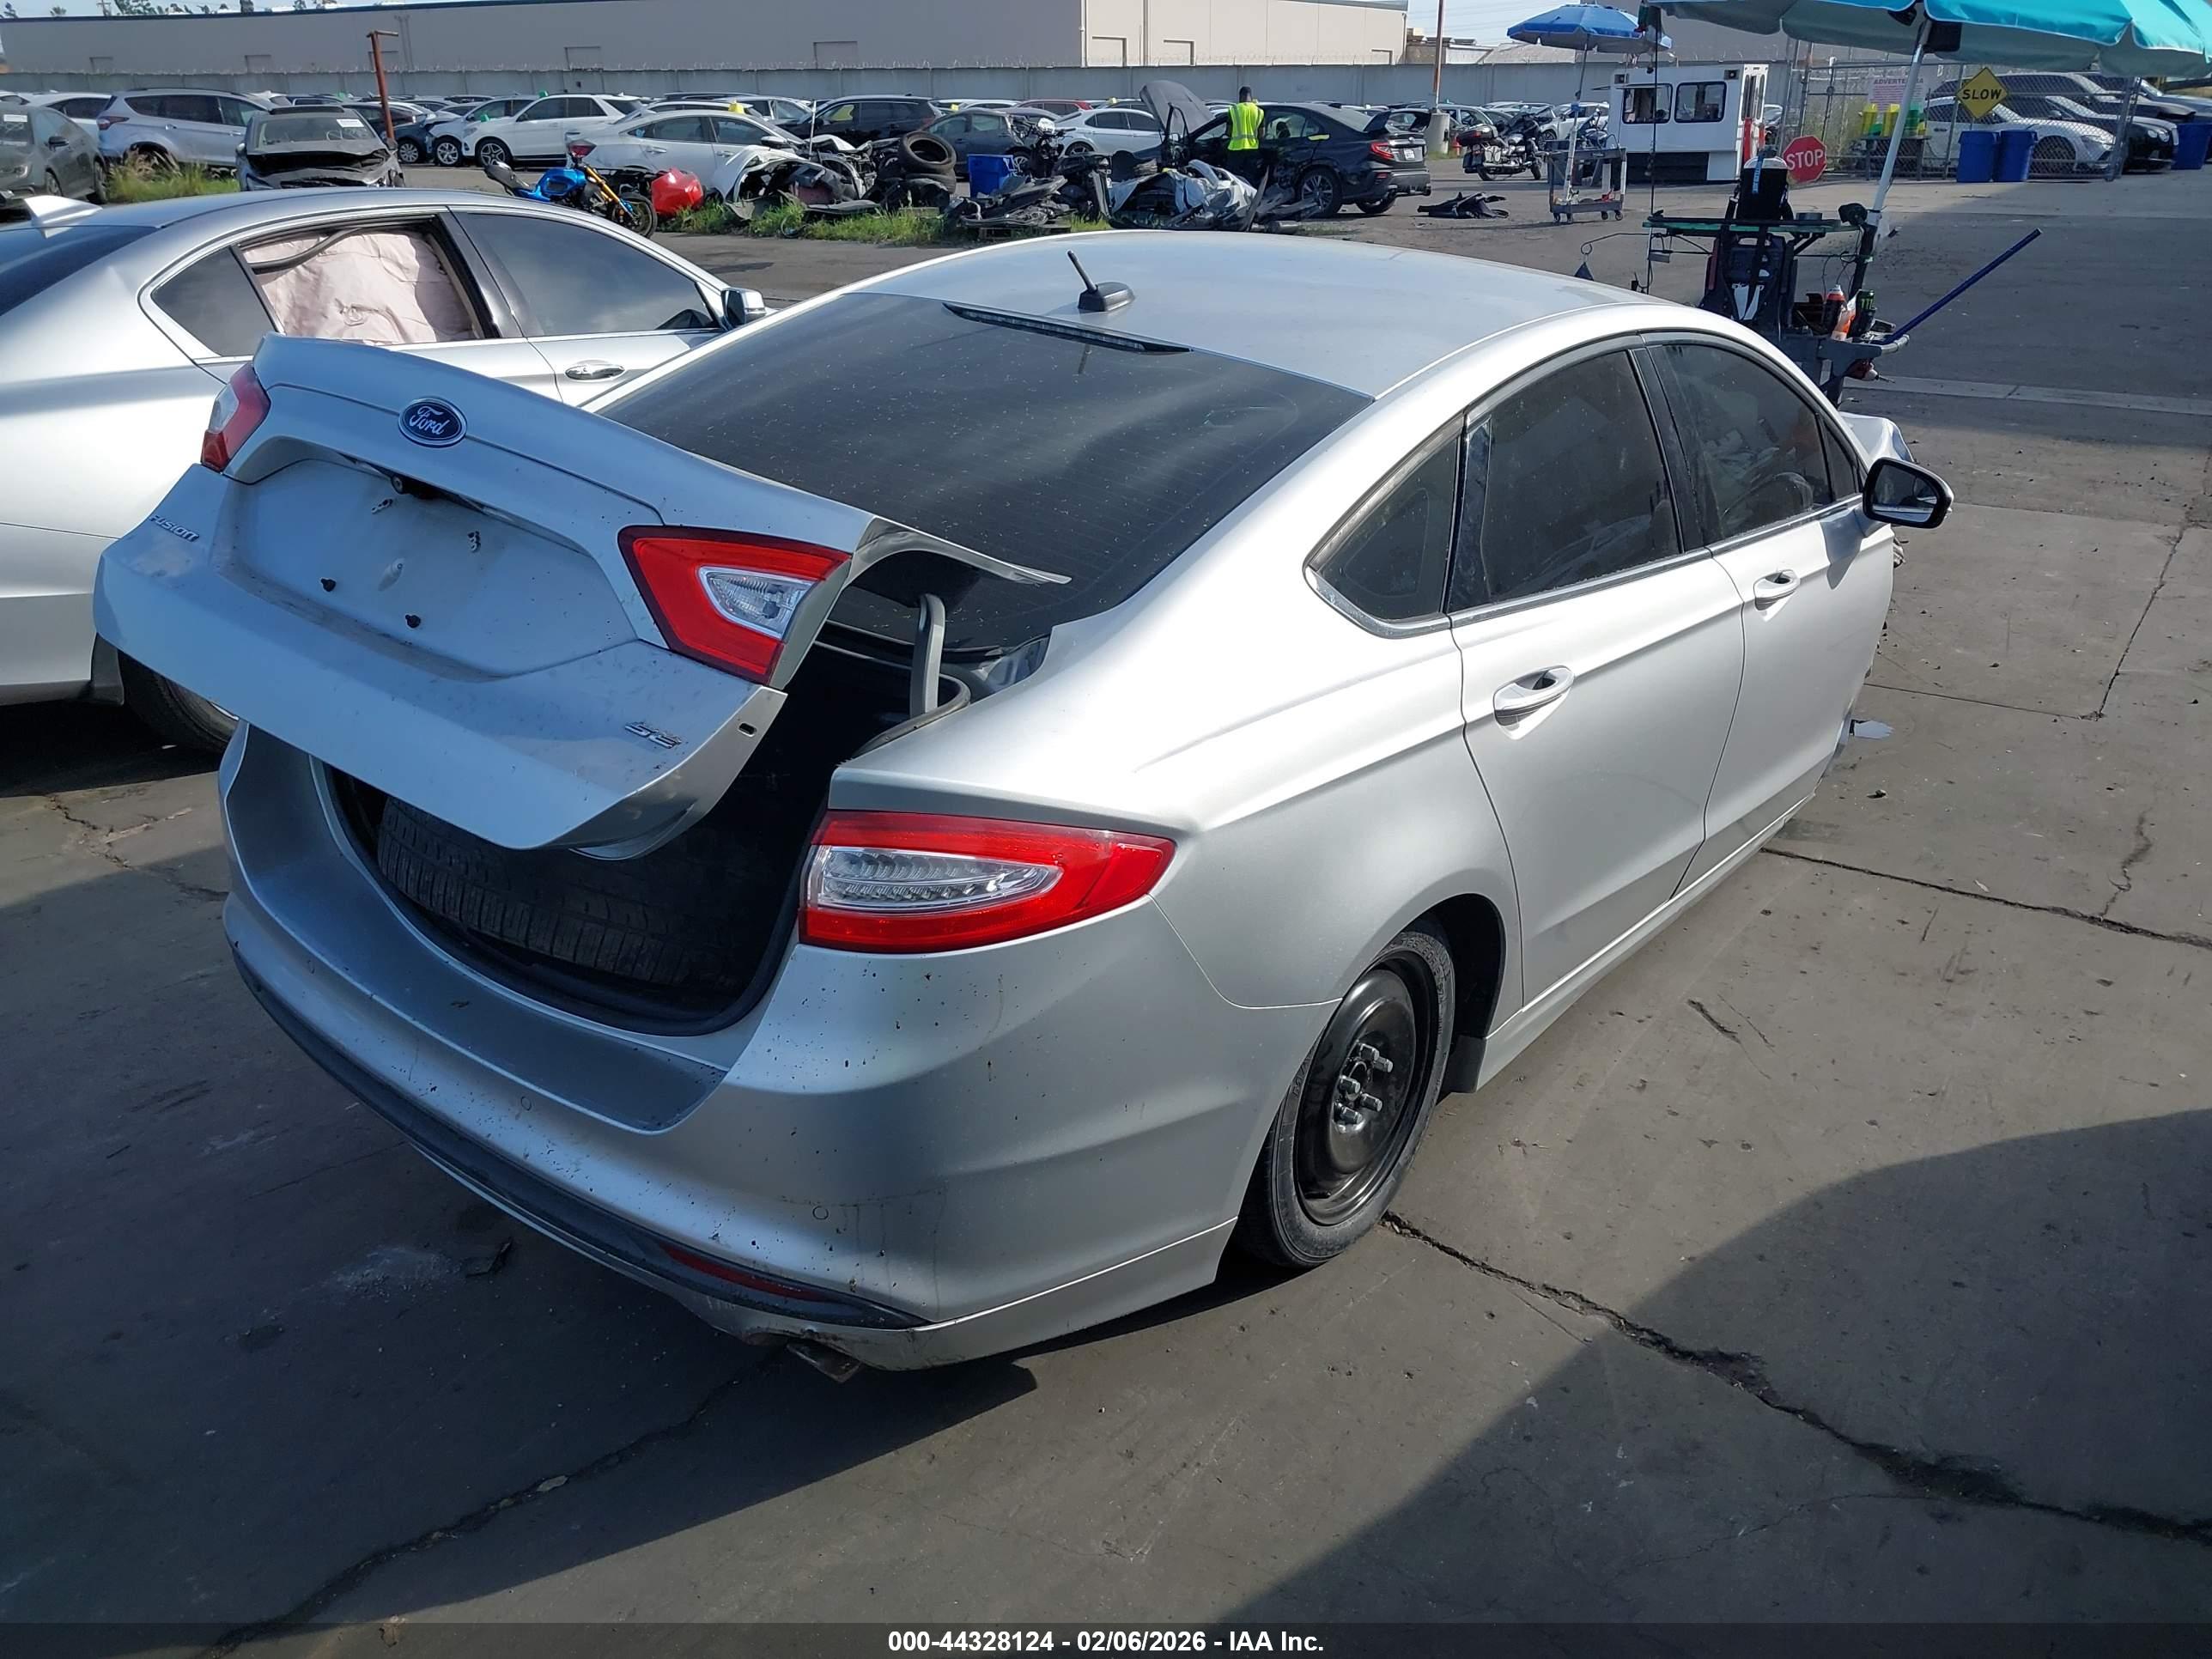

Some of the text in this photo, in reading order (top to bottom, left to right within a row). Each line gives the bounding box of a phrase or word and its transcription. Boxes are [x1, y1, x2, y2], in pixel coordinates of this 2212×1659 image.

[1962, 88, 2002, 100] SLOW
[1786, 149, 1824, 171] STOP
[409, 405, 451, 434] Ford
[624, 722, 682, 749] SE
